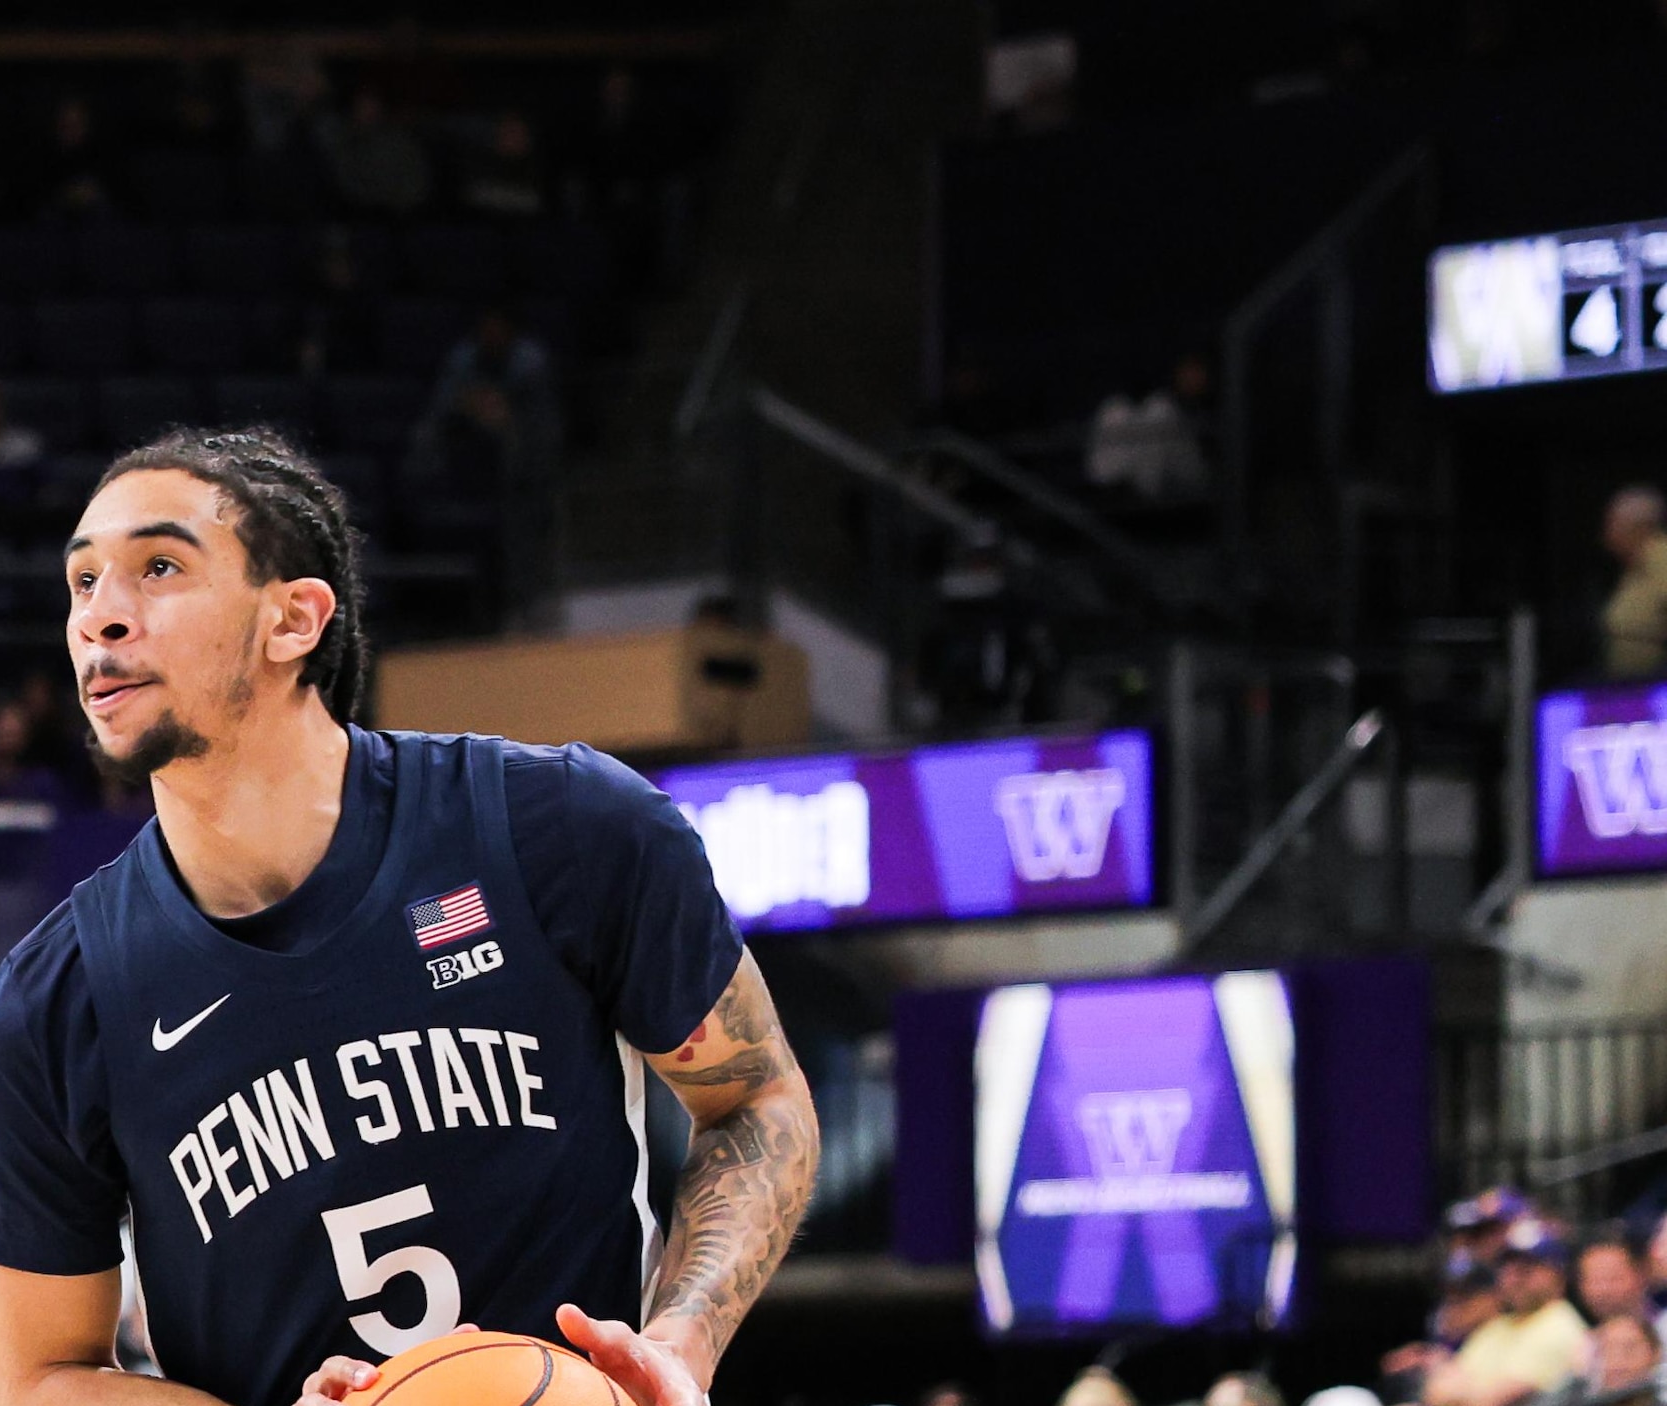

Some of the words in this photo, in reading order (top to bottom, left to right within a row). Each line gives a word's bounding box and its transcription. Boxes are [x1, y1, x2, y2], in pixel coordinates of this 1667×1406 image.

[993, 768, 1126, 881] W
[168, 1056, 335, 1245] PENN
[335, 1027, 557, 1145] STATE
[321, 1183, 462, 1357] 5
